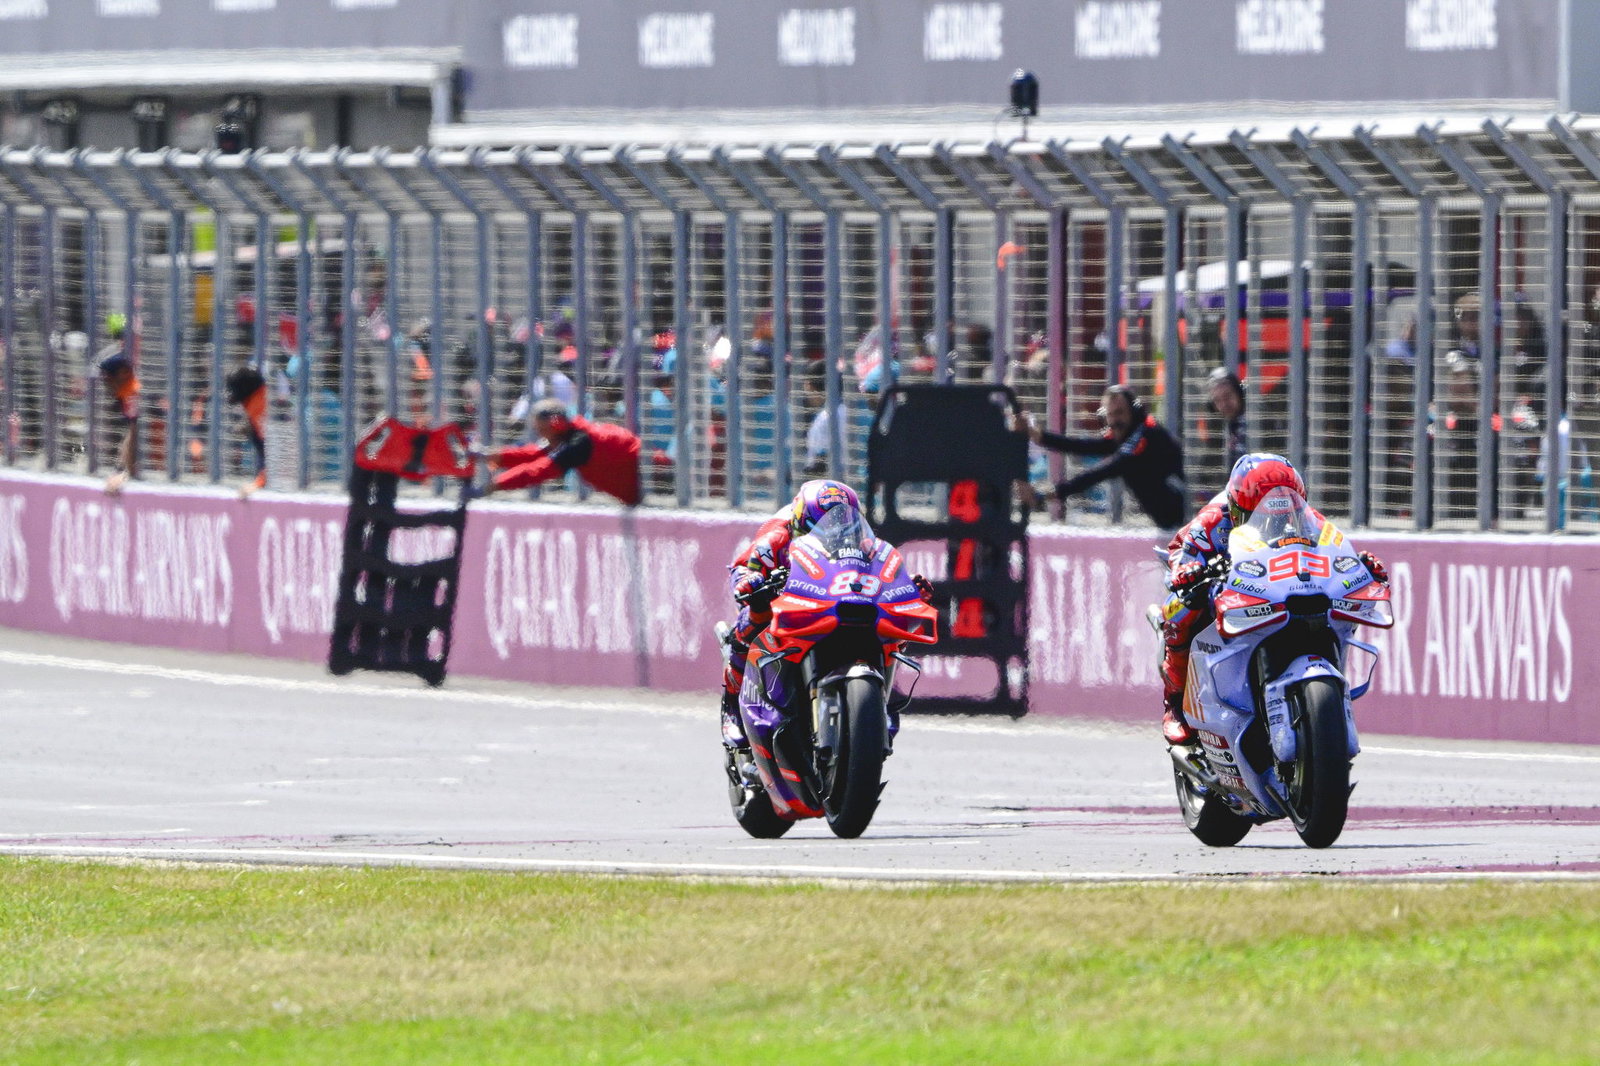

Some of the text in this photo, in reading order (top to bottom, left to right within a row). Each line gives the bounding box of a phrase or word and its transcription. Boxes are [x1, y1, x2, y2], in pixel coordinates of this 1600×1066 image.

[838, 548, 863, 559] FIAMM
[1267, 550, 1331, 582] 93
[789, 580, 826, 595] prima
[829, 571, 881, 596] 89
[881, 584, 915, 601] prima
[1420, 562, 1573, 703] AIRWAYS
